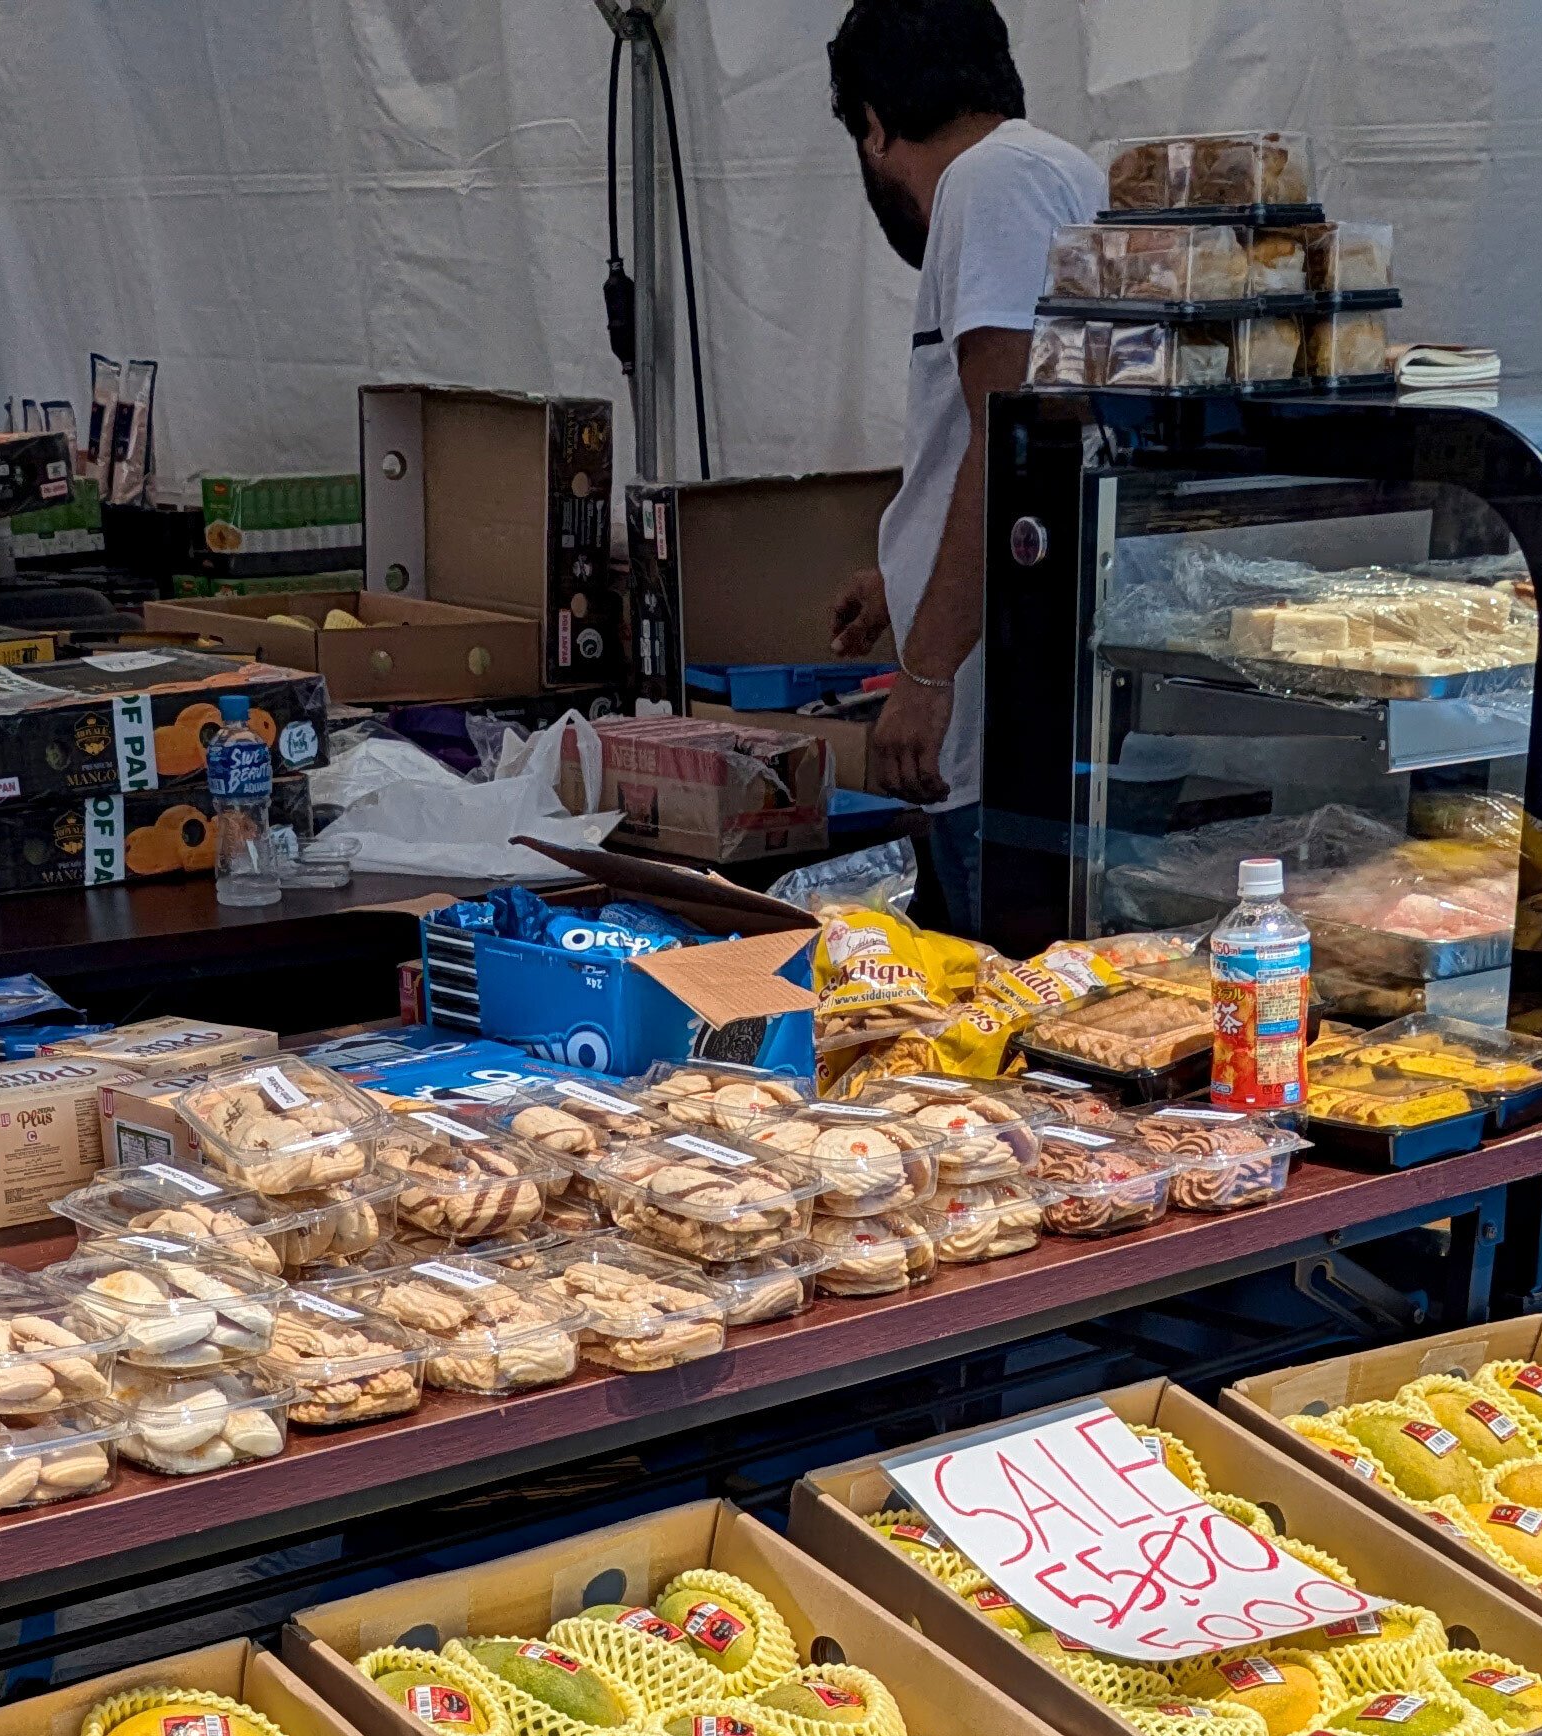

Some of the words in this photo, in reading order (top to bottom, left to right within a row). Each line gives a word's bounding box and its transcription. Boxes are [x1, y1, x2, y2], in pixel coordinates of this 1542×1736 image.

[92, 796, 115, 836] OF
[16, 1108, 55, 1131] Plus
[934, 1412, 1209, 1567] SALE
[1137, 1578, 1370, 1654] 5000
